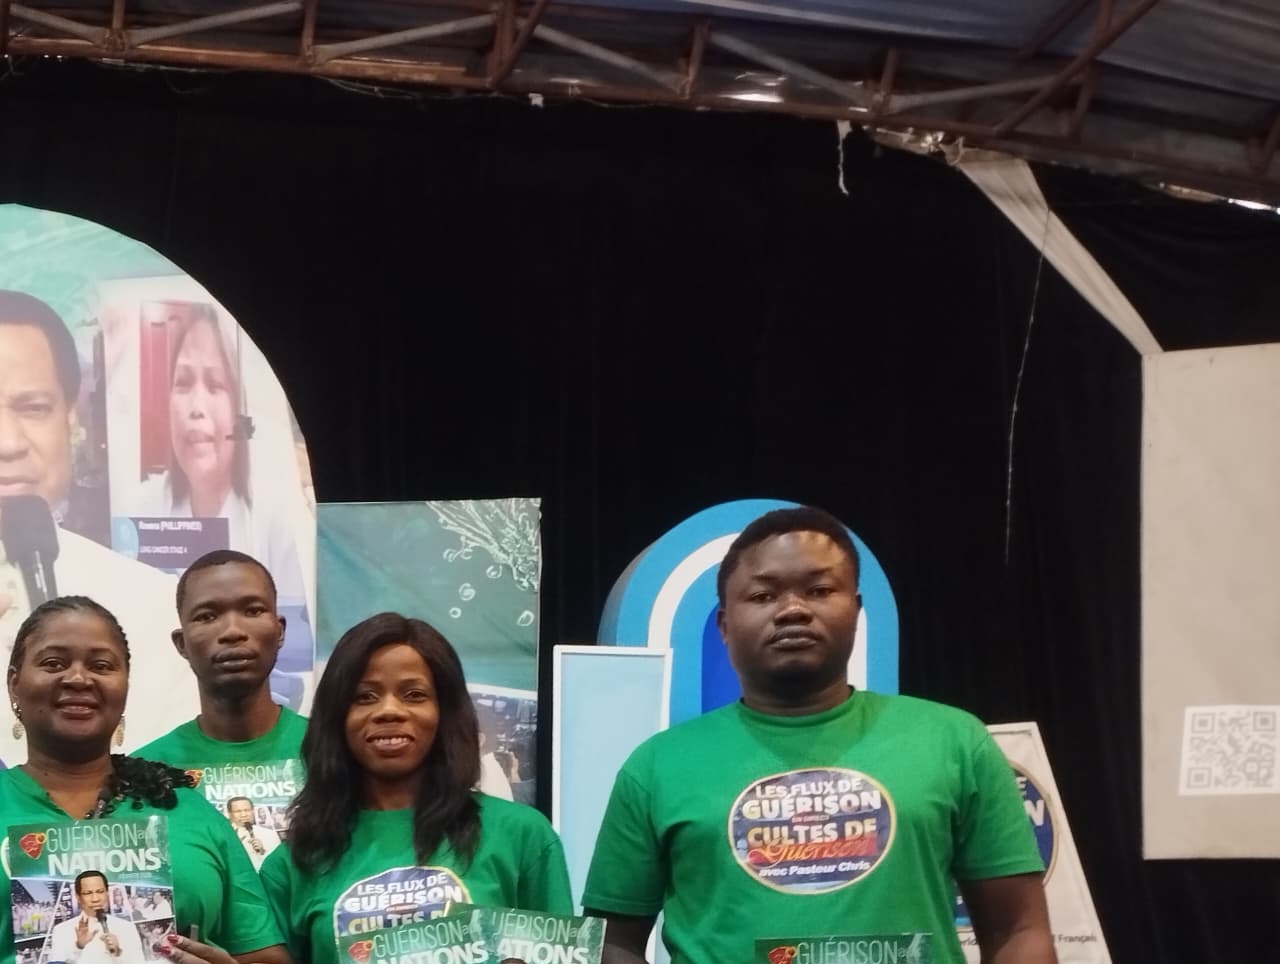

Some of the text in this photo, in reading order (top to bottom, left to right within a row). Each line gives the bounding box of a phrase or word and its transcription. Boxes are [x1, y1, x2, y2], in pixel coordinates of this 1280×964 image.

[203, 763, 278, 785] GUÉRISON
[204, 780, 297, 801] NATIONS
[756, 778, 863, 799] LES FLUX DE
[742, 789, 882, 819] GUÉRISON
[45, 820, 139, 853] GUÉRISON
[747, 818, 877, 847] CULTES DE
[47, 847, 162, 877] NATIONS
[759, 860, 871, 877] avec Pasteur Chris
[356, 872, 449, 896] LES FLUX DE
[343, 885, 463, 913] GUÉRISON
[372, 920, 464, 958] GUÉRISON
[492, 908, 572, 944] UÉRISON
[1058, 934, 1097, 944] Français
